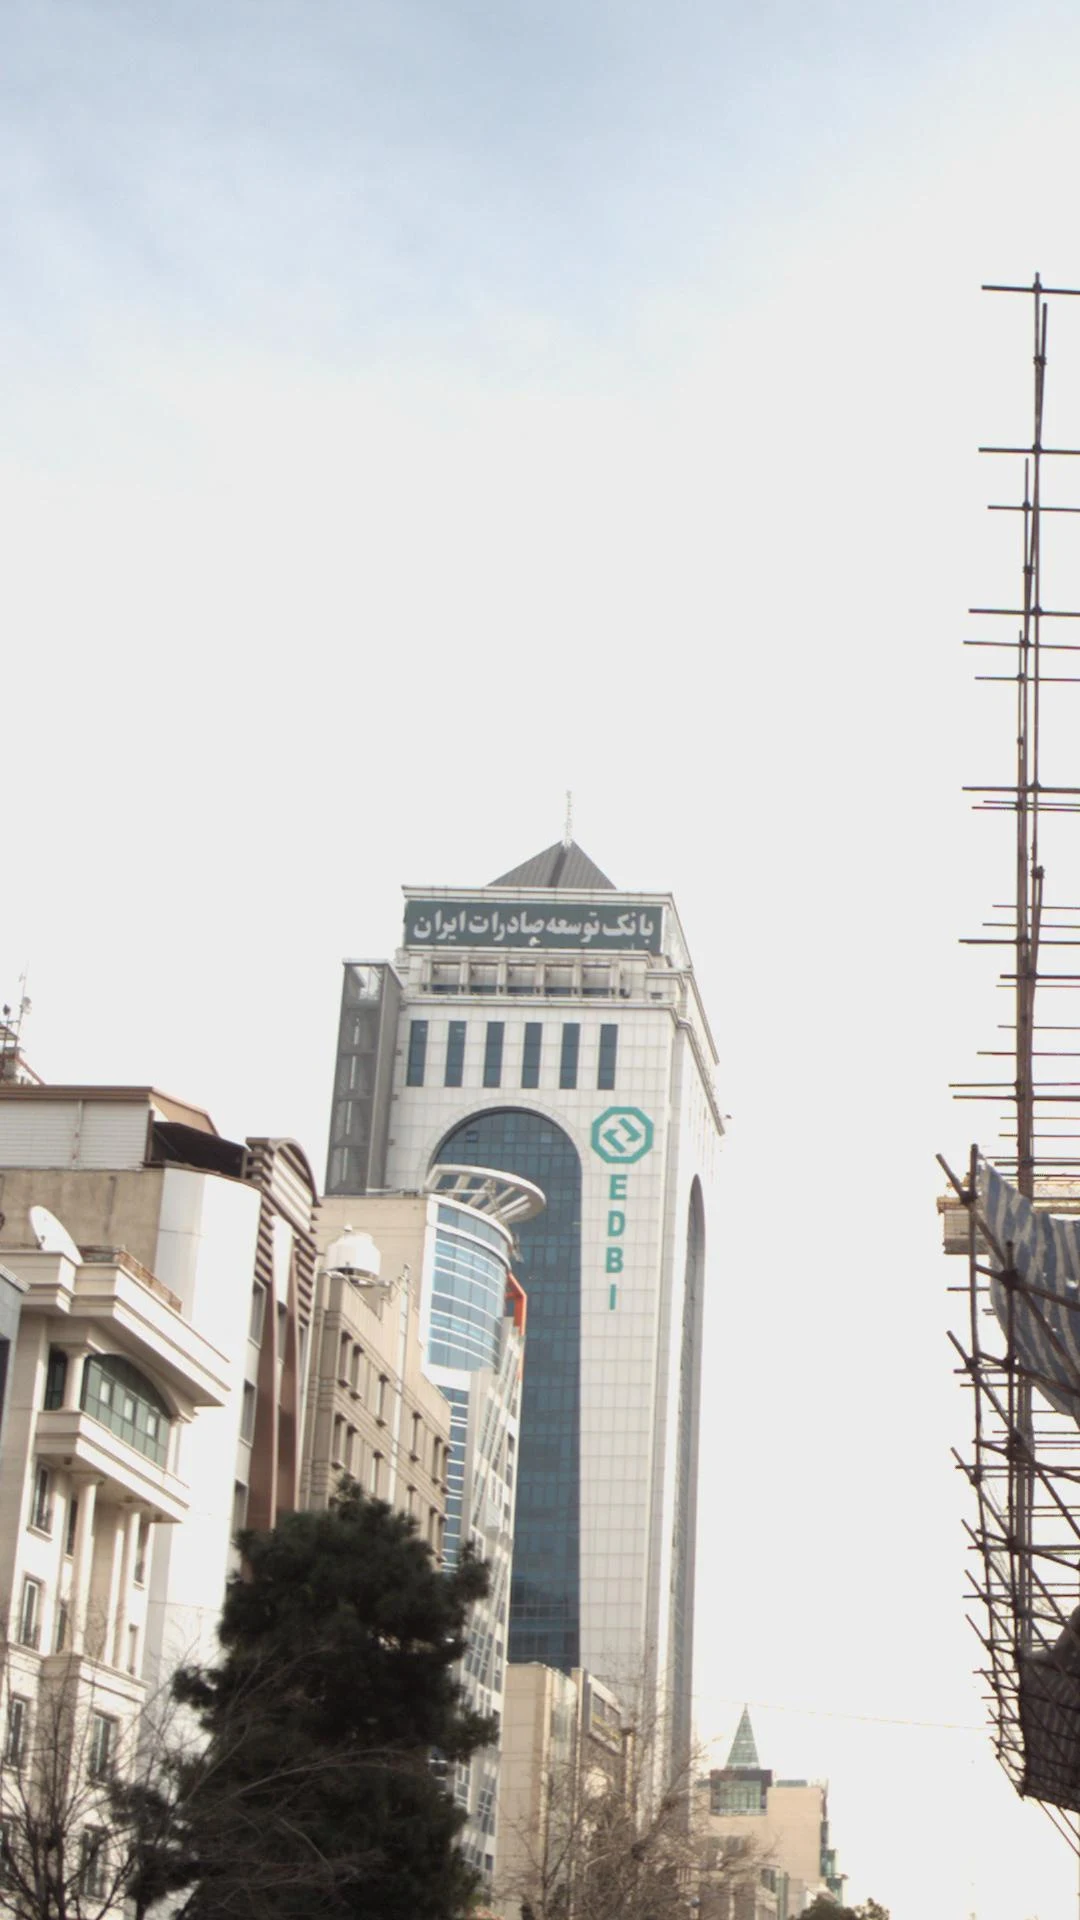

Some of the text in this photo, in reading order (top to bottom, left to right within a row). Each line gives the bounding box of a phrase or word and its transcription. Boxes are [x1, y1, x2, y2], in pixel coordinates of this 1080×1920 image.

[413, 909, 655, 944] بانک توسعه صادرات ایران
[605, 1174, 628, 1310] EDBI
